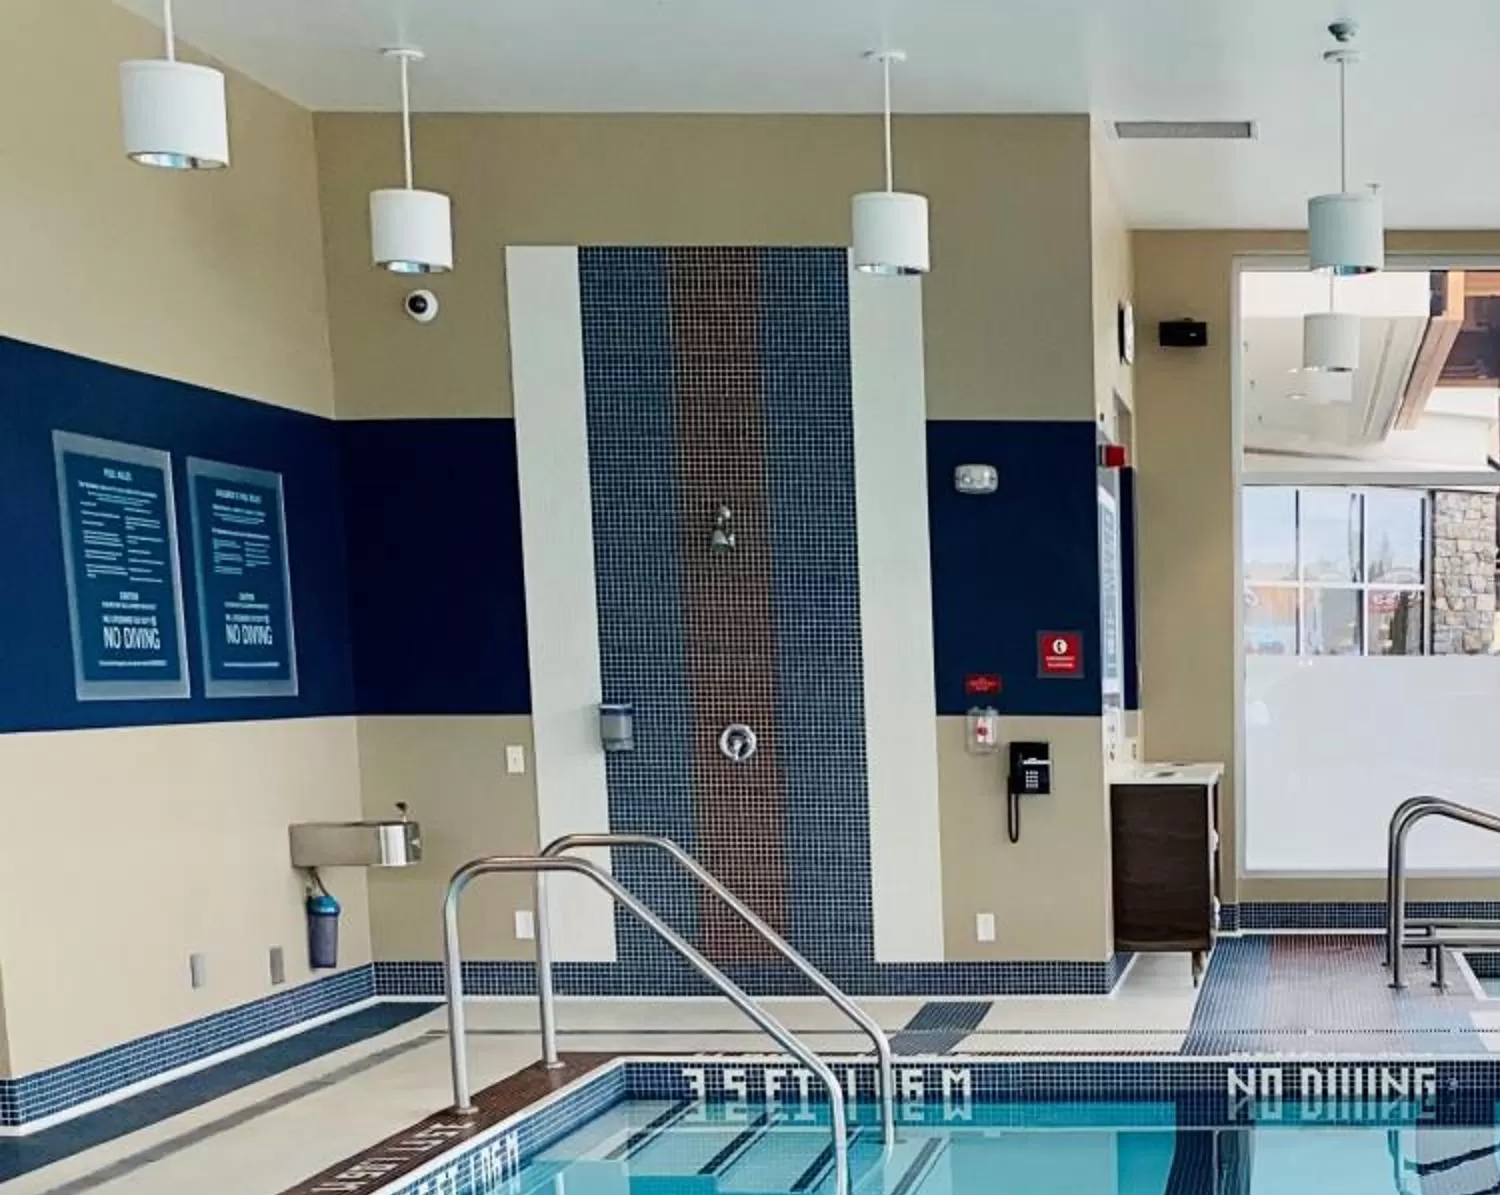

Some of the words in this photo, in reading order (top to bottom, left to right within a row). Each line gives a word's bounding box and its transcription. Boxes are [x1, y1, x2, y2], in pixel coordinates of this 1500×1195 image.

[103, 626, 121, 649] NO
[123, 626, 161, 651] DIVING
[225, 623, 241, 645] NO
[241, 624, 273, 646] DIVING
[1227, 1067, 1283, 1096] NO
